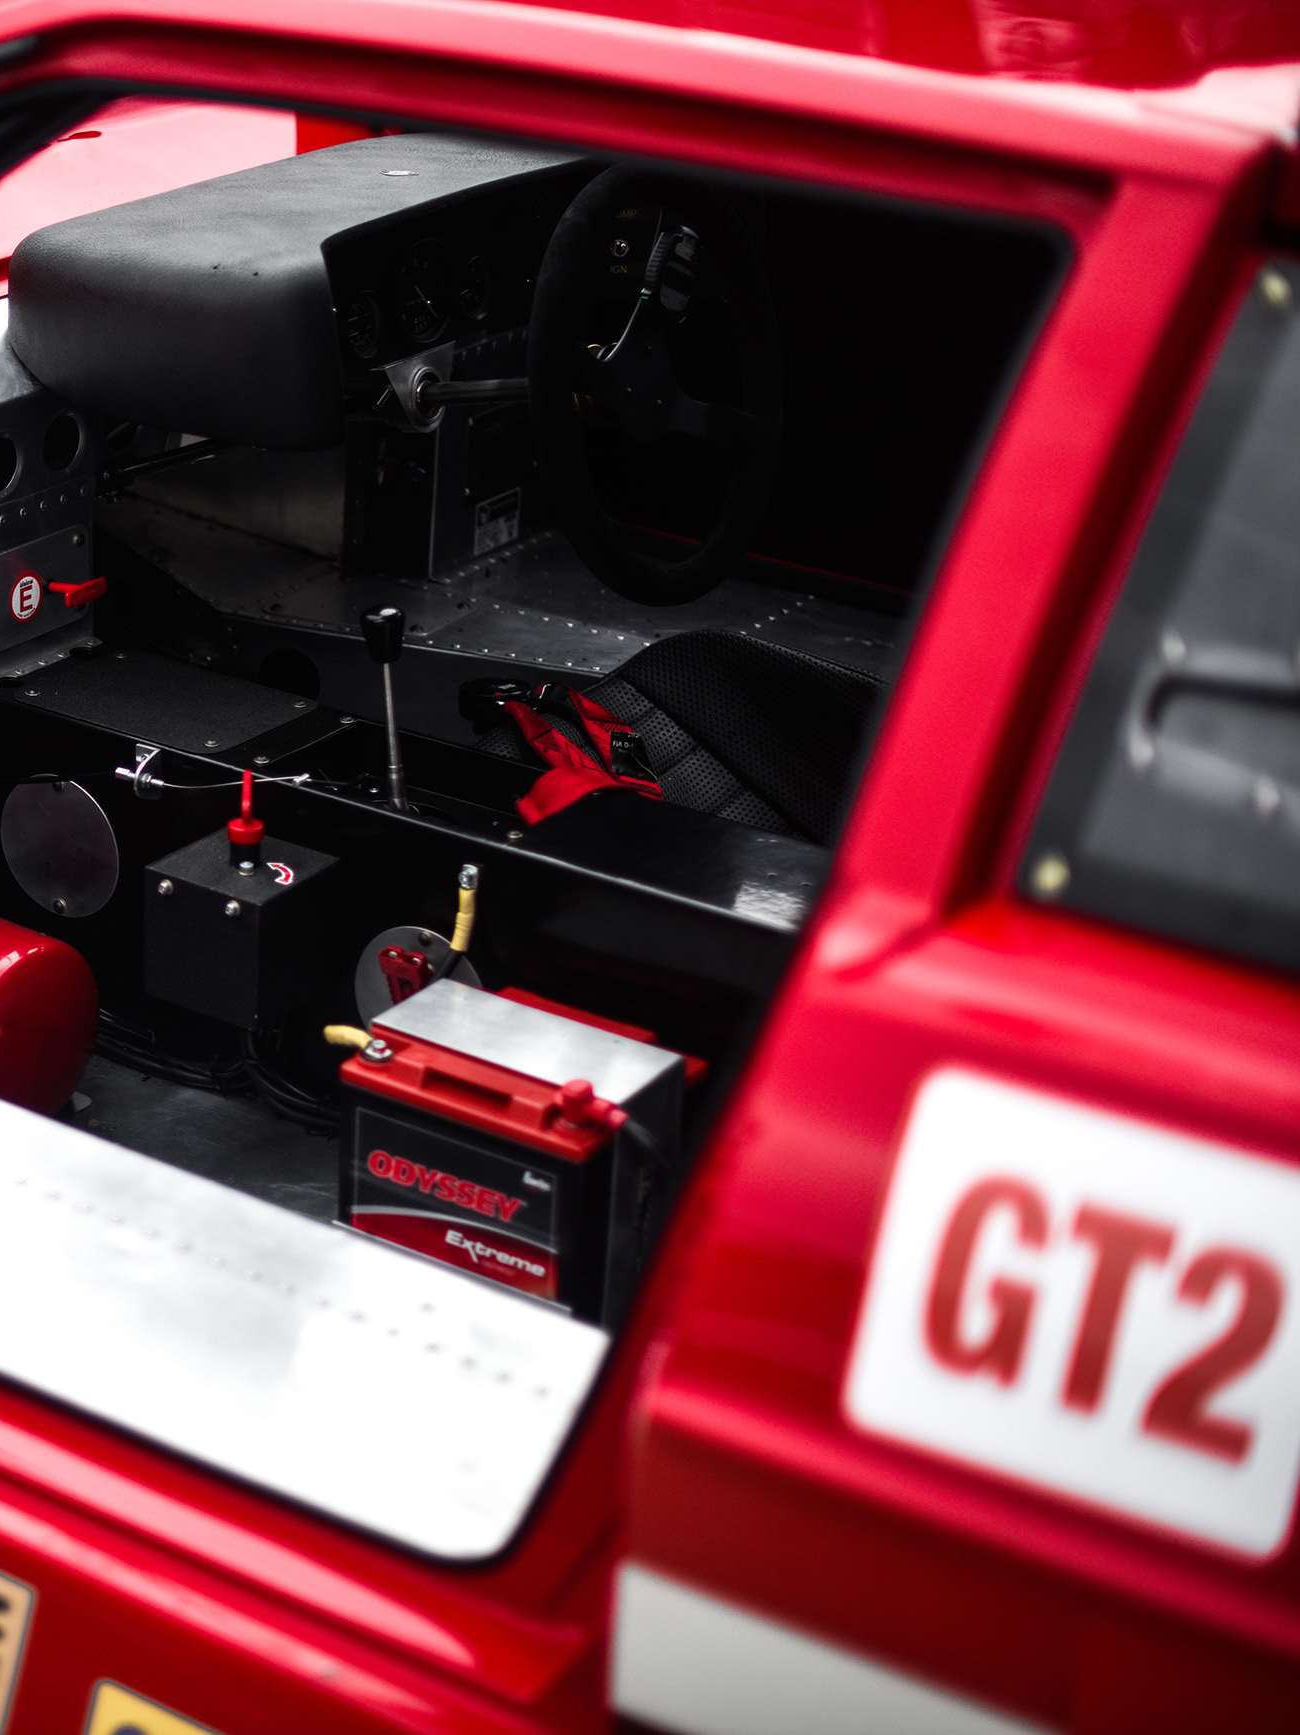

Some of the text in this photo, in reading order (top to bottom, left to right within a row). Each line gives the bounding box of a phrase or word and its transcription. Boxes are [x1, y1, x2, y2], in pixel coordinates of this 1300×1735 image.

[19, 584, 34, 613] E
[367, 1150, 522, 1222] ODYSSEY
[445, 1229, 546, 1277] Extreme
[921, 1171, 1287, 1467] GT2
